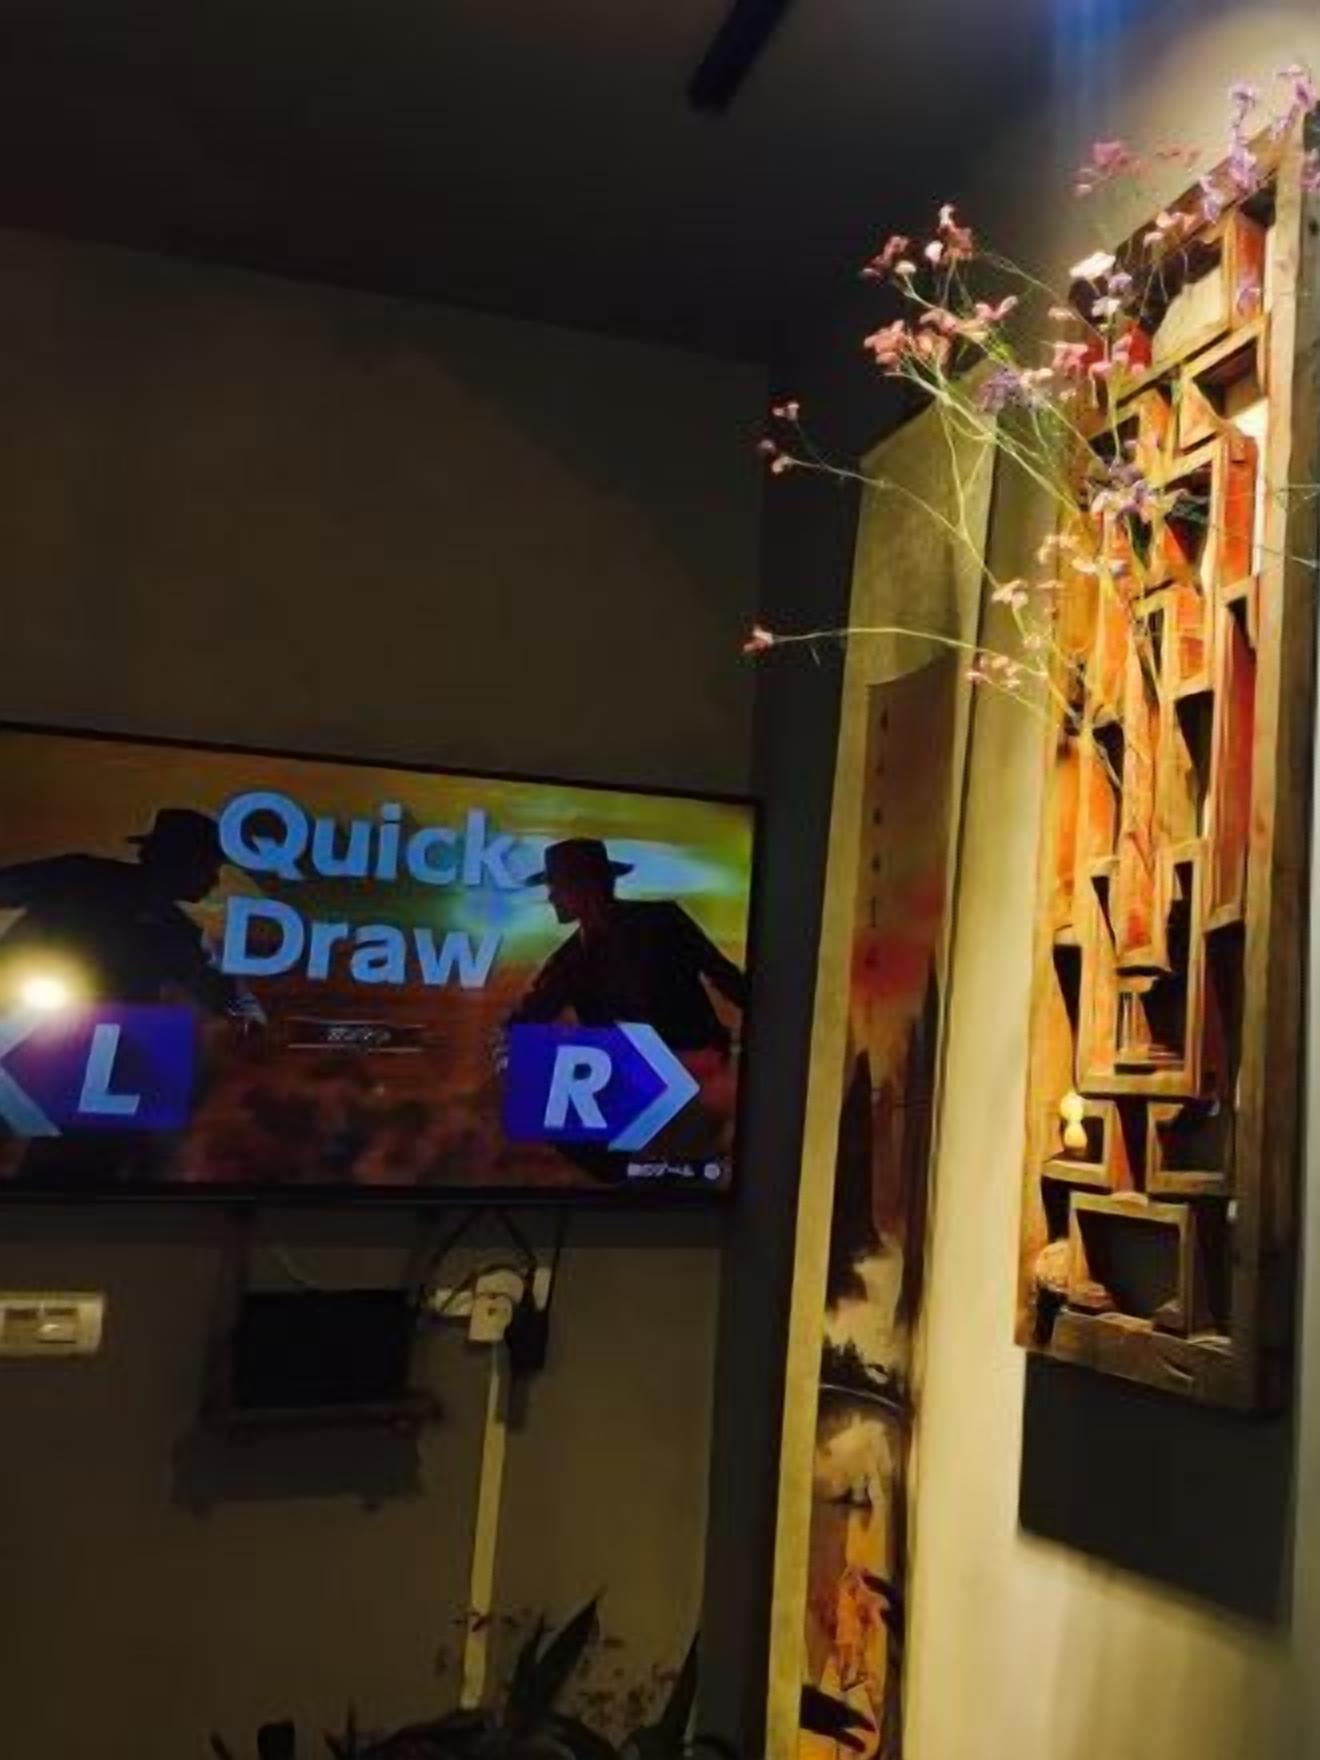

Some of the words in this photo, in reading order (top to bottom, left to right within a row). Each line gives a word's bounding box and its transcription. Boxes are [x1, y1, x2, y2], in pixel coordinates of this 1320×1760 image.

[219, 791, 524, 890] Quick
[221, 895, 504, 989] Draw
[78, 1024, 141, 1115] L
[542, 1045, 612, 1130] R
